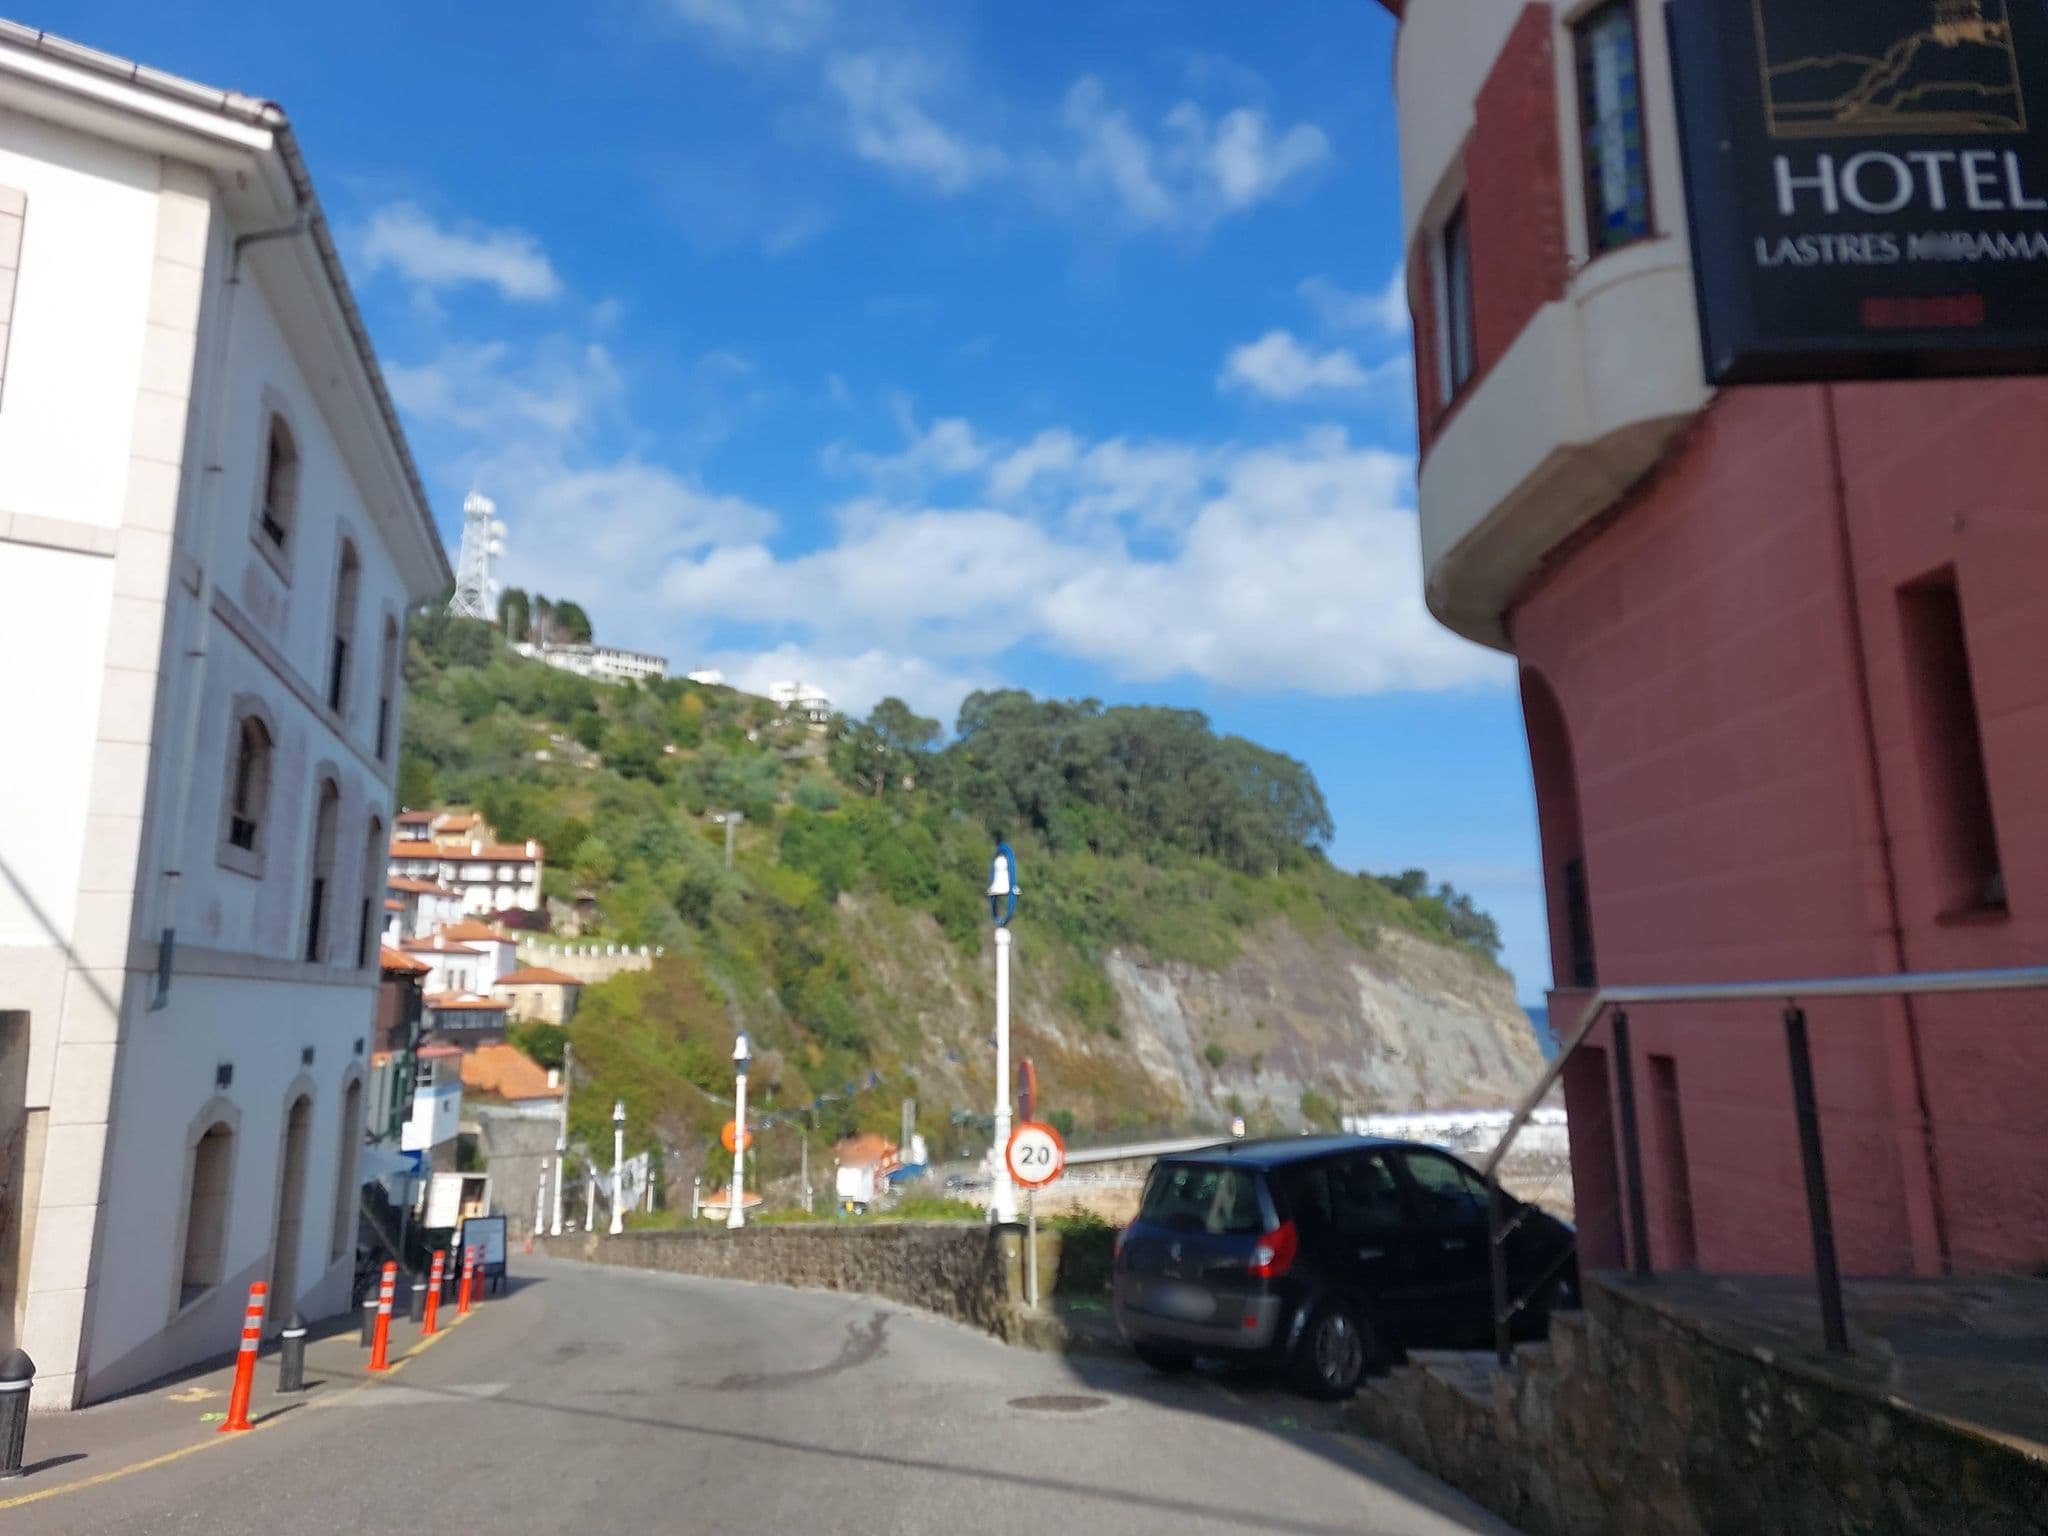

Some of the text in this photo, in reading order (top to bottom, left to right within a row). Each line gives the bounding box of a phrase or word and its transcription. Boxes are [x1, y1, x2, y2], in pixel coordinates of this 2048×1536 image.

[1773, 150, 2047, 216] HOTEL
[1754, 232, 1900, 267] LASTRES
[1021, 1146, 1050, 1166] 20
